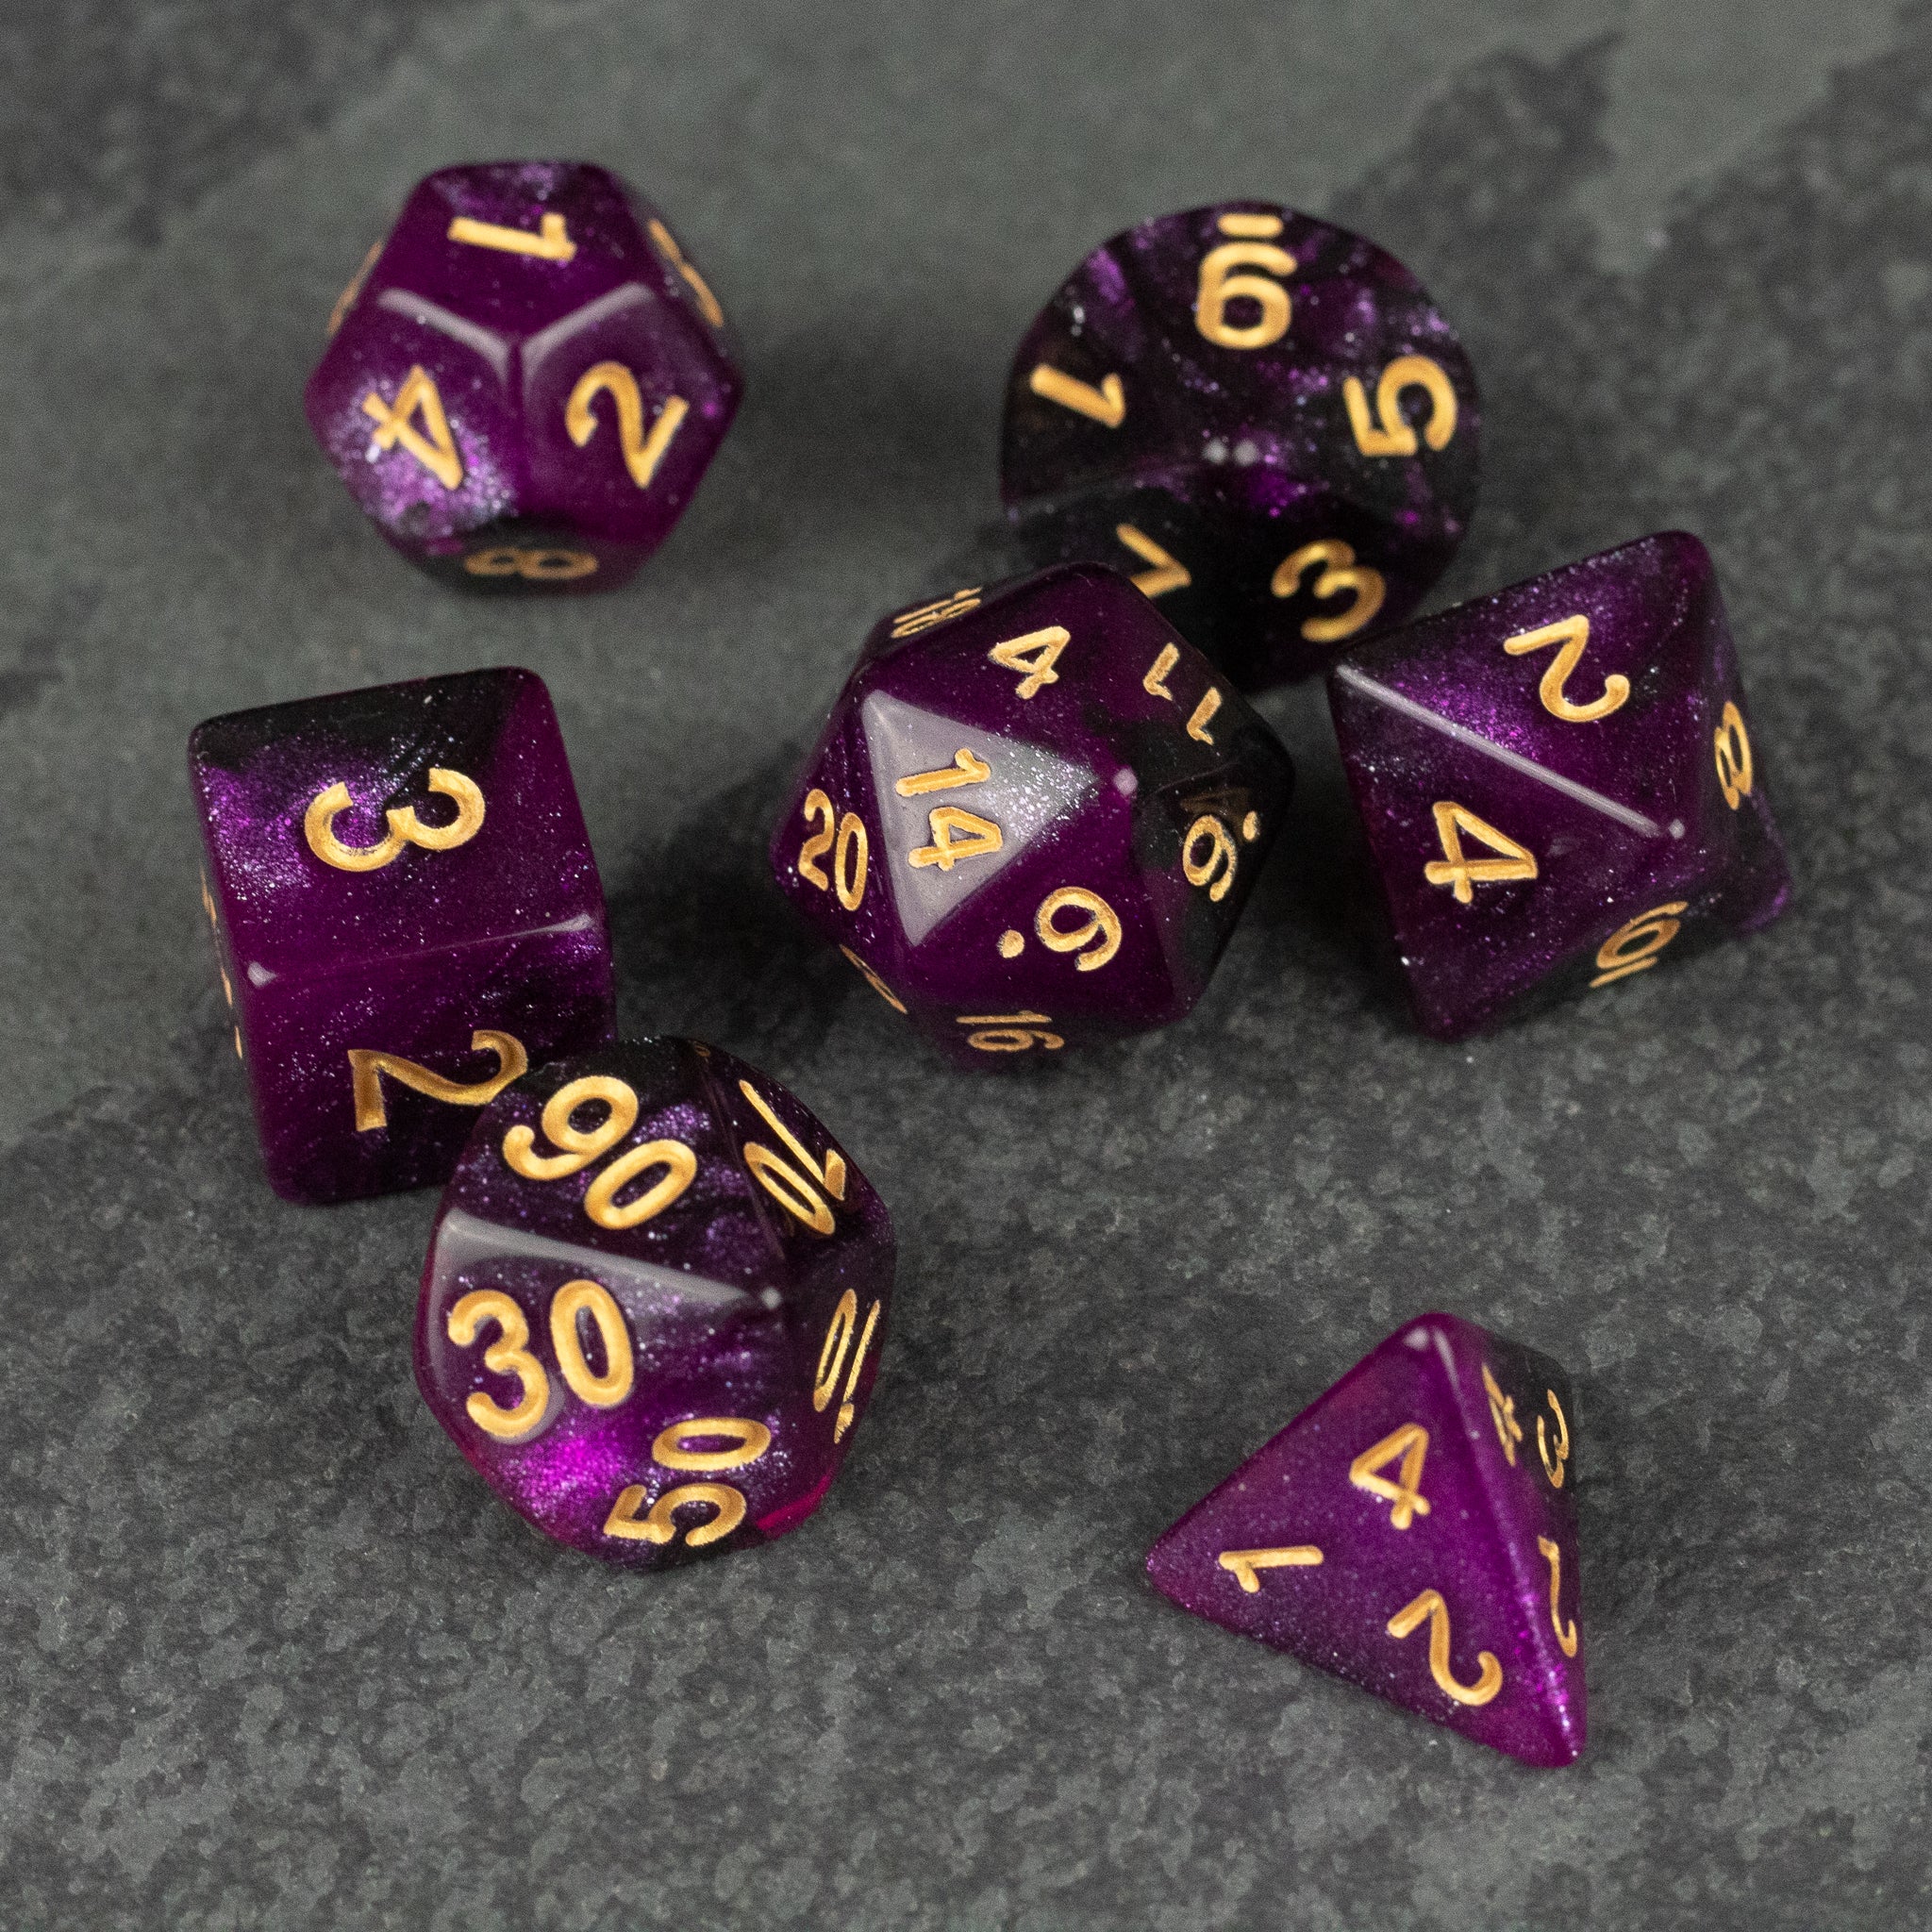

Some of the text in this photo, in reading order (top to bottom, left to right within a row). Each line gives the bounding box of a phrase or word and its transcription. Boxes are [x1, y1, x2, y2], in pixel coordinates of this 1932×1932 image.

[447, 212, 576, 261] 1
[361, 366, 463, 488] 4
[565, 363, 689, 489] 2
[1028, 362, 1126, 429] 1
[1341, 355, 1458, 458] 5
[464, 544, 599, 580] 8
[1271, 540, 1386, 642] 3
[989, 625, 1072, 700] 4
[1498, 614, 1631, 724] 2
[304, 766, 487, 873] 3
[797, 788, 870, 911] 20
[895, 748, 1006, 871] 14
[1423, 800, 1539, 905] 4
[347, 1029, 530, 1133] 2
[955, 1009, 1066, 1053] 16
[501, 1074, 699, 1231] 90
[738, 1079, 848, 1236] 70
[446, 1277, 636, 1441] 30
[603, 1417, 772, 1549] 50
[1349, 1422, 1431, 1530] 4
[1217, 1544, 1324, 1594] 1
[1387, 1589, 1503, 1707] 2
